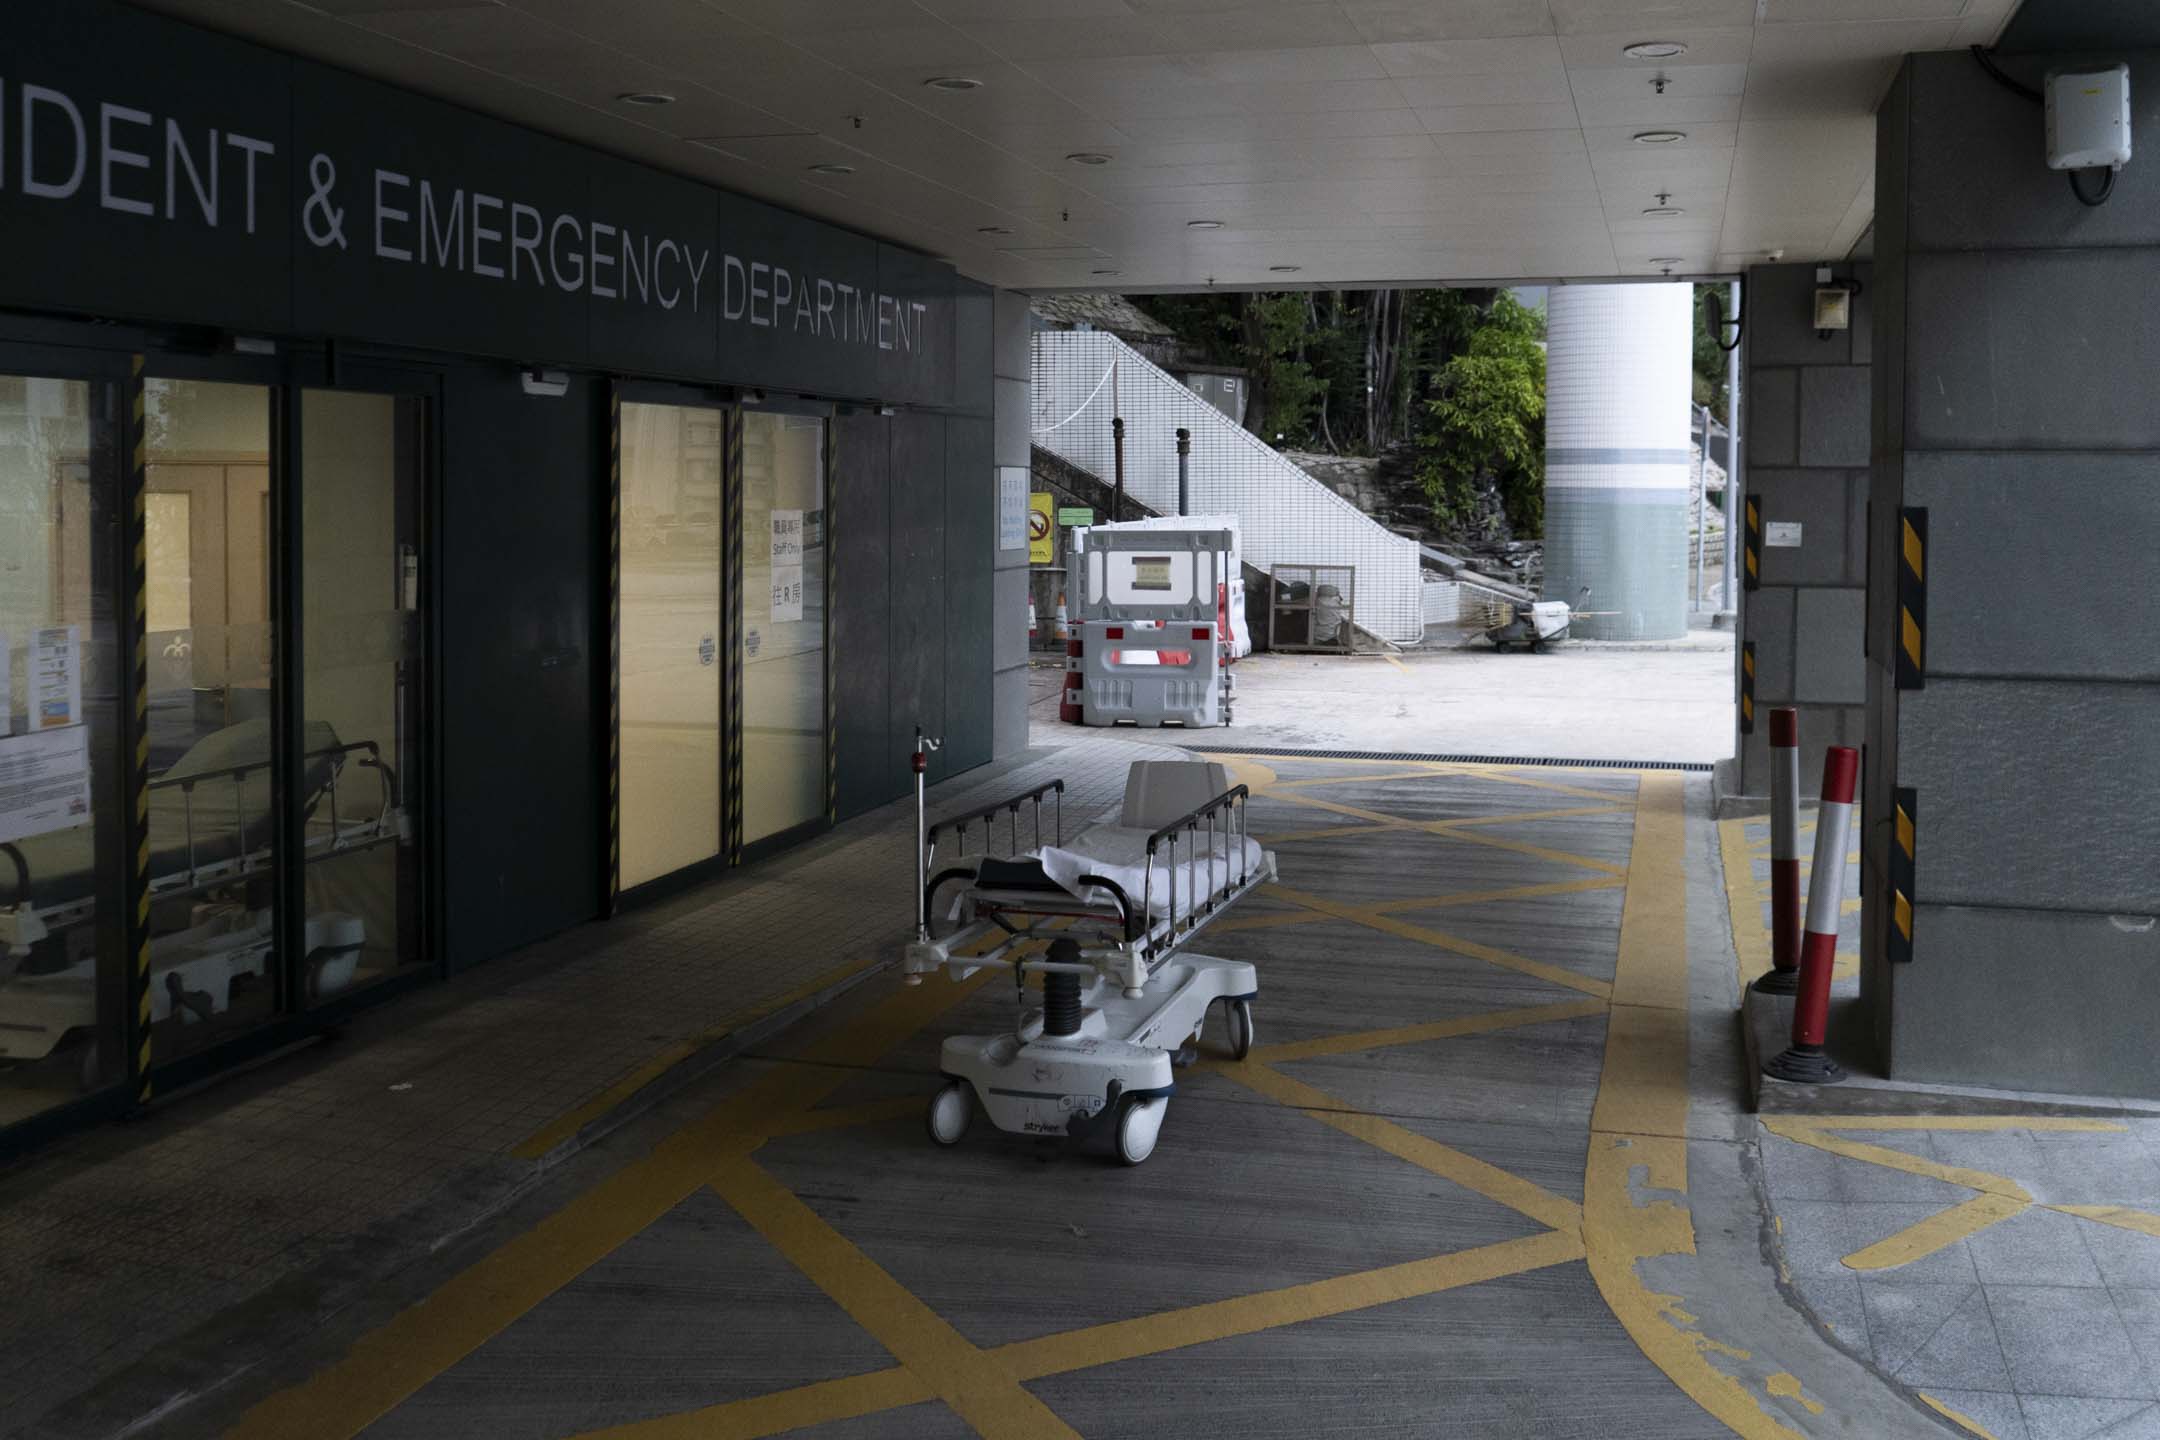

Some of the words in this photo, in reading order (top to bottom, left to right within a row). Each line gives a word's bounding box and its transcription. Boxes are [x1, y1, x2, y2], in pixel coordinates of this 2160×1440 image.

[302, 153, 347, 249] &
[375, 169, 709, 313] EMERGENCY
[723, 254, 927, 355] DEPARTMENT
[773, 542, 787, 555] Staff
